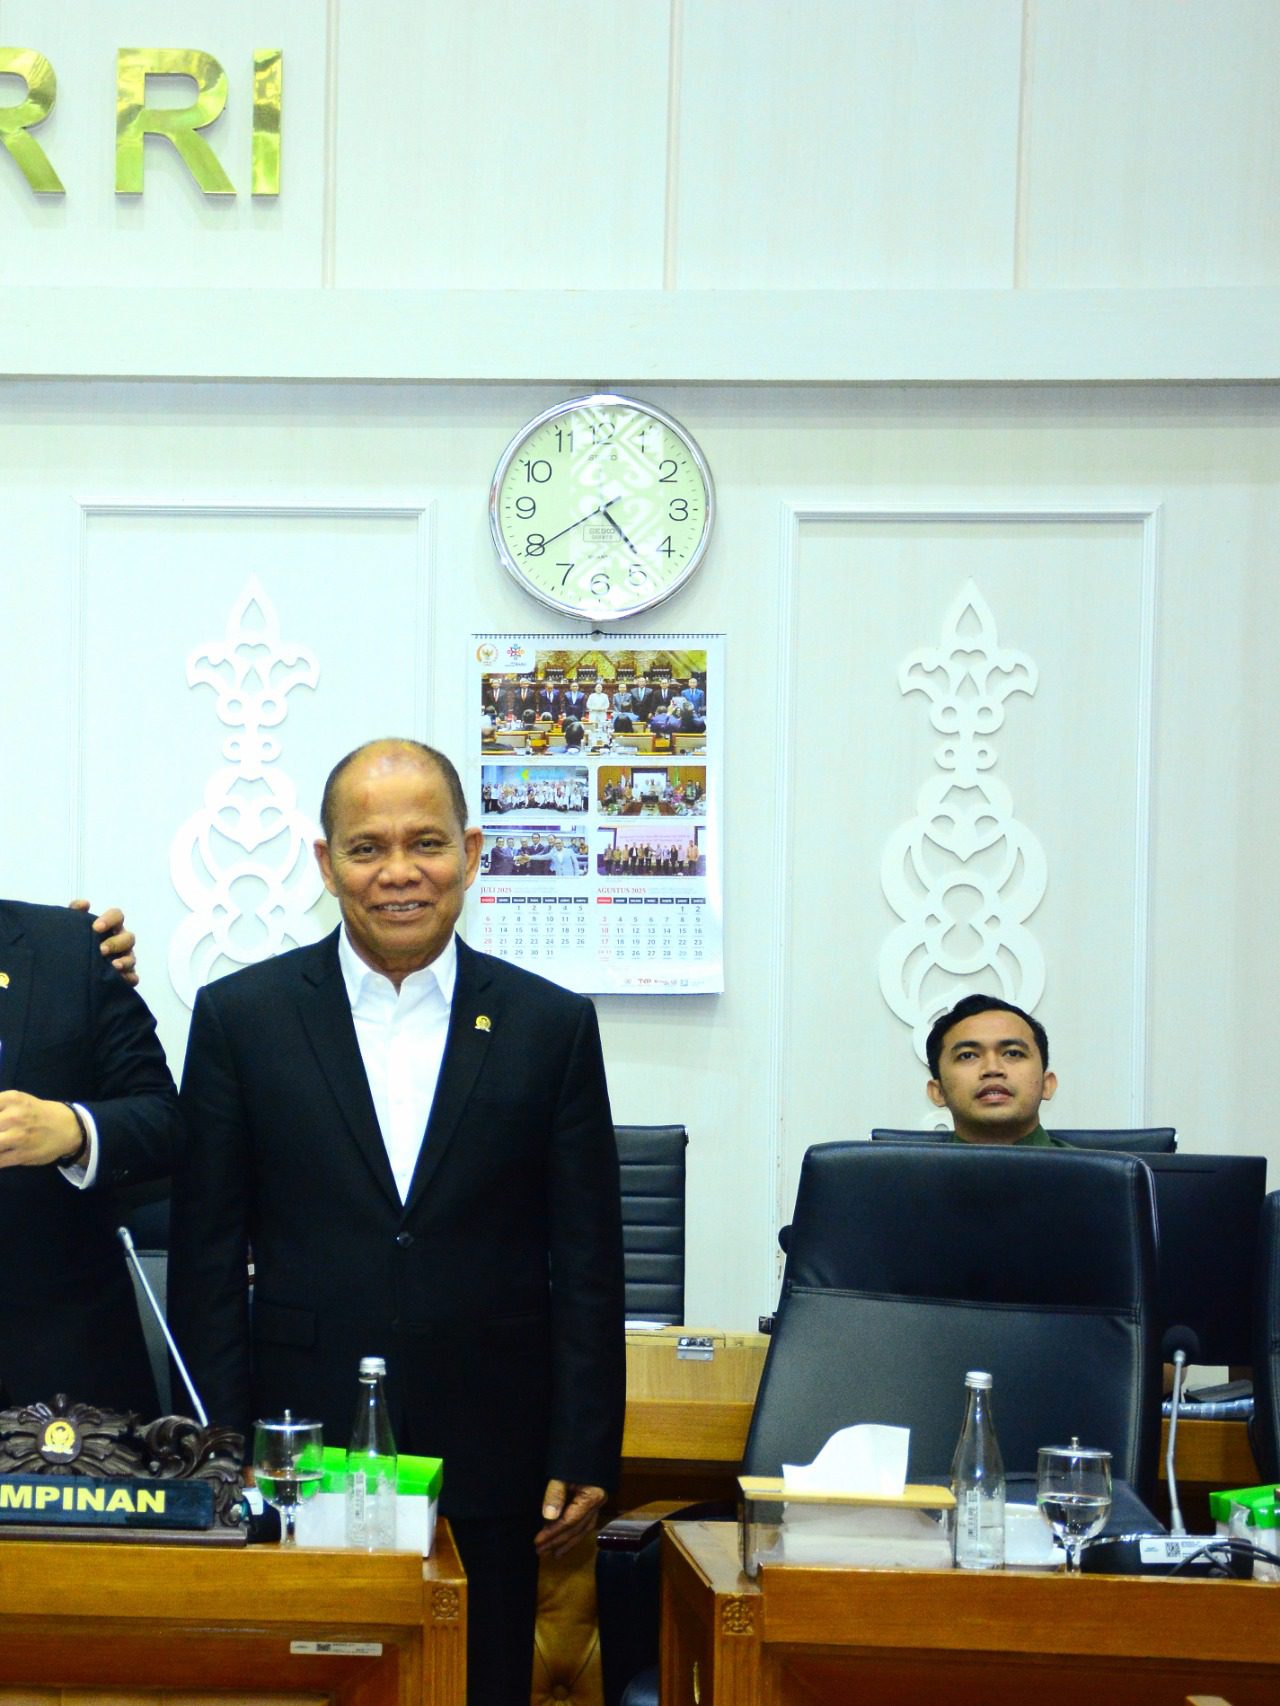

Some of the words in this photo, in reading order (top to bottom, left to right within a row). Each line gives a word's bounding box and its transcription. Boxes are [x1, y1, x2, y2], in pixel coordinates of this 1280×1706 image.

[115, 48, 283, 196] RI
[555, 430, 574, 453] 11
[589, 422, 616, 446] 12
[524, 460, 552, 483] 10
[658, 460, 678, 483] 2
[516, 496, 536, 520] 9
[669, 498, 688, 522] 3
[526, 533, 545, 557] 8
[656, 536, 676, 558] 4
[556, 563, 574, 586] 7
[590, 573, 610, 596] 6
[628, 564, 647, 586] 5
